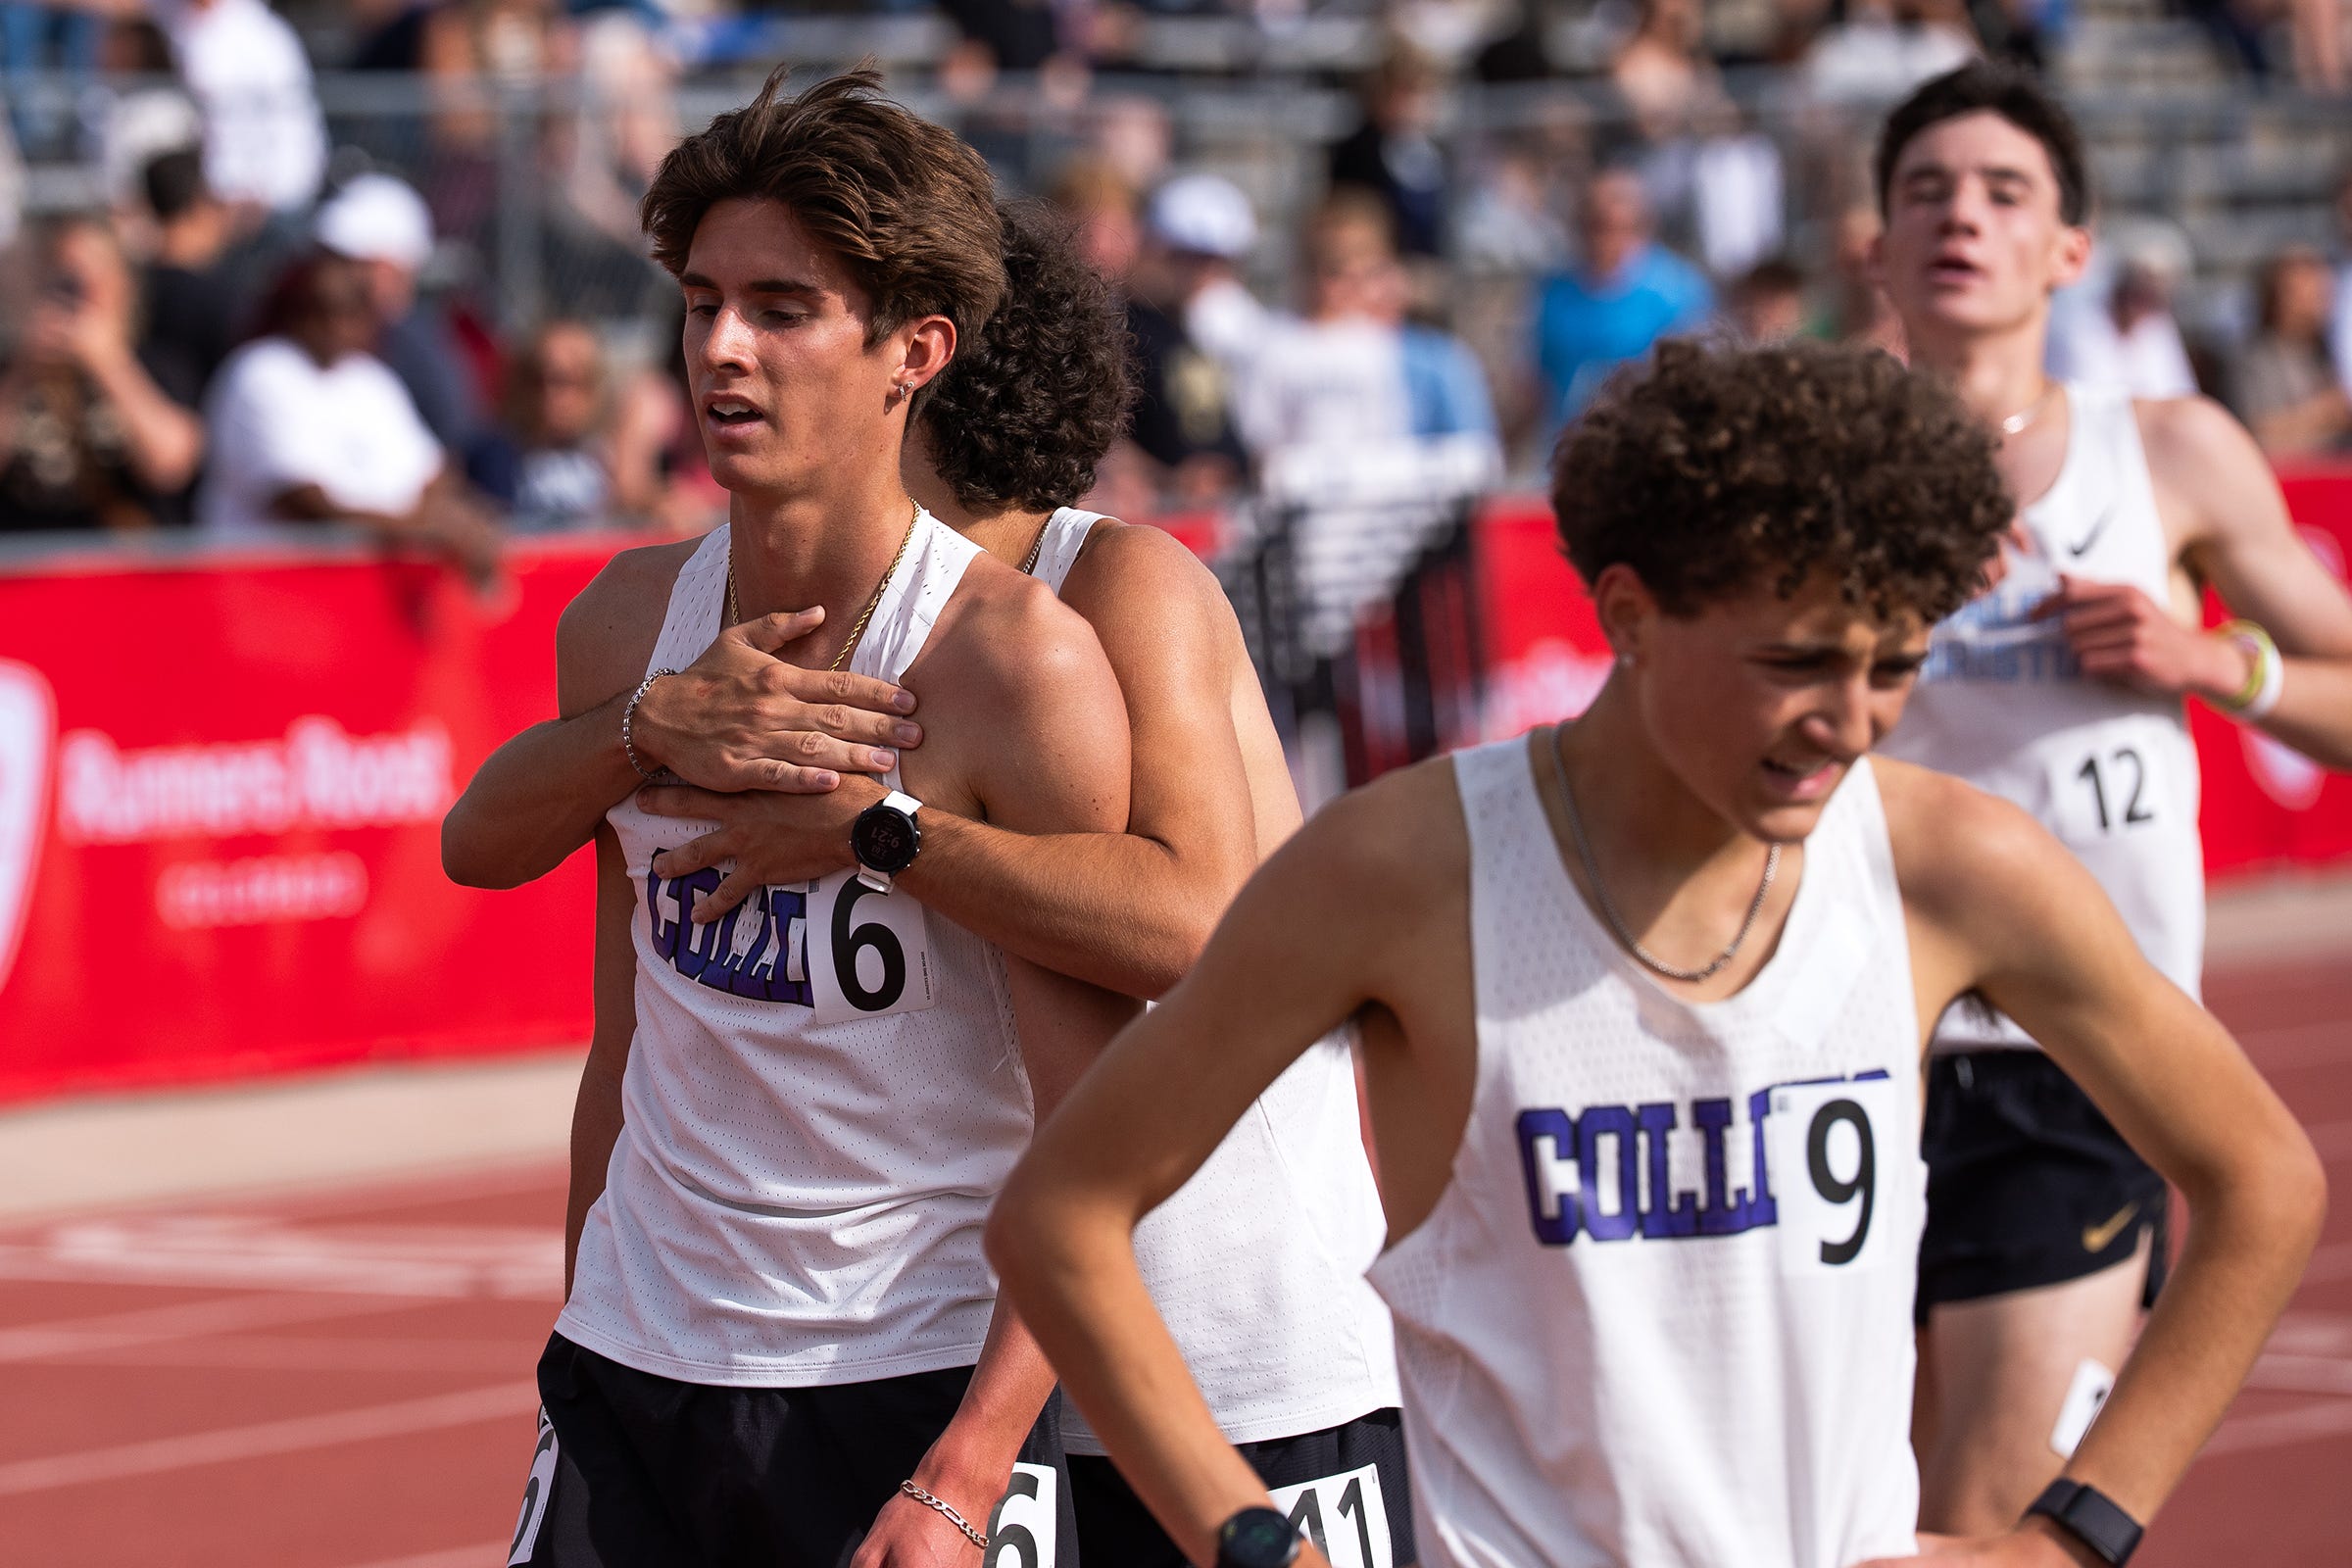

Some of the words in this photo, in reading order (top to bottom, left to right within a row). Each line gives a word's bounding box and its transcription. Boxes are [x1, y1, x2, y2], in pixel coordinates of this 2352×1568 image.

[871, 826, 901, 849] 9:21
[2078, 749, 2154, 828] 12
[647, 847, 815, 1008] COLLI
[831, 875, 906, 1011] 6
[1516, 1068, 1890, 1248] COLLI
[1807, 1098, 1876, 1266] 9
[982, 1471, 1039, 1568] 6
